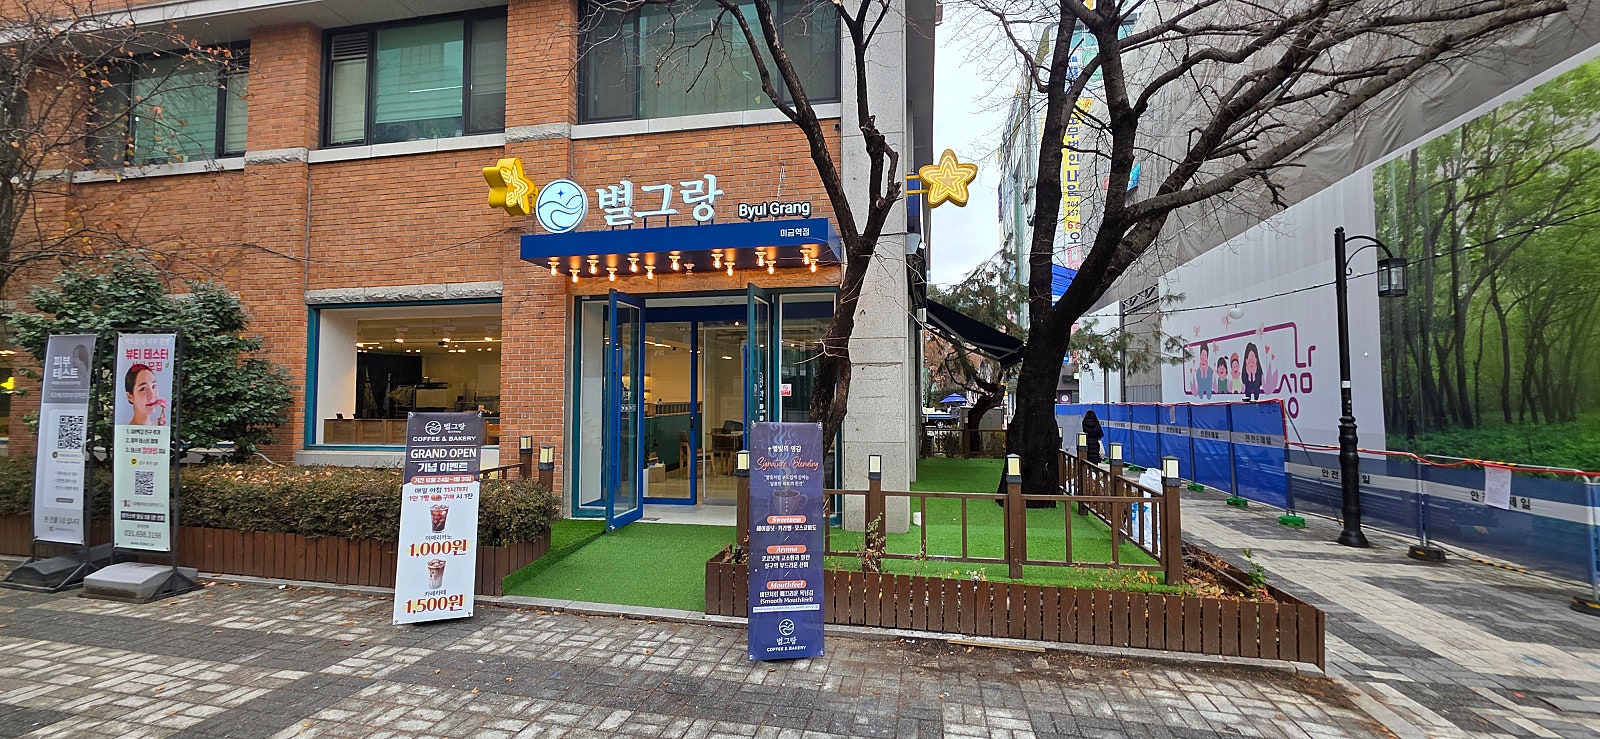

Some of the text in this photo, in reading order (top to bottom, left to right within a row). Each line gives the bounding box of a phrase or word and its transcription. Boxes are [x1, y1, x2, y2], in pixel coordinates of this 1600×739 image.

[596, 174, 724, 226] 별그랑
[738, 201, 811, 219] Byul Grang
[780, 227, 810, 238] 미금역점
[126, 348, 169, 360] 뷰티 테스터
[53, 355, 71, 368] 피부
[148, 361, 162, 372] 모집
[52, 368, 79, 380] 테스트
[443, 422, 466, 431] 별그랑
[411, 448, 477, 459] GRAND OPEN
[771, 445, 788, 453] 별빛의
[417, 462, 468, 473] 기념 이벤트
[754, 456, 819, 471] Signature Blending
[409, 539, 467, 558] 1,000원
[424, 589, 447, 597] 카페라떼
[406, 594, 463, 614] 1,500원
[776, 636, 797, 645] 별그랑
